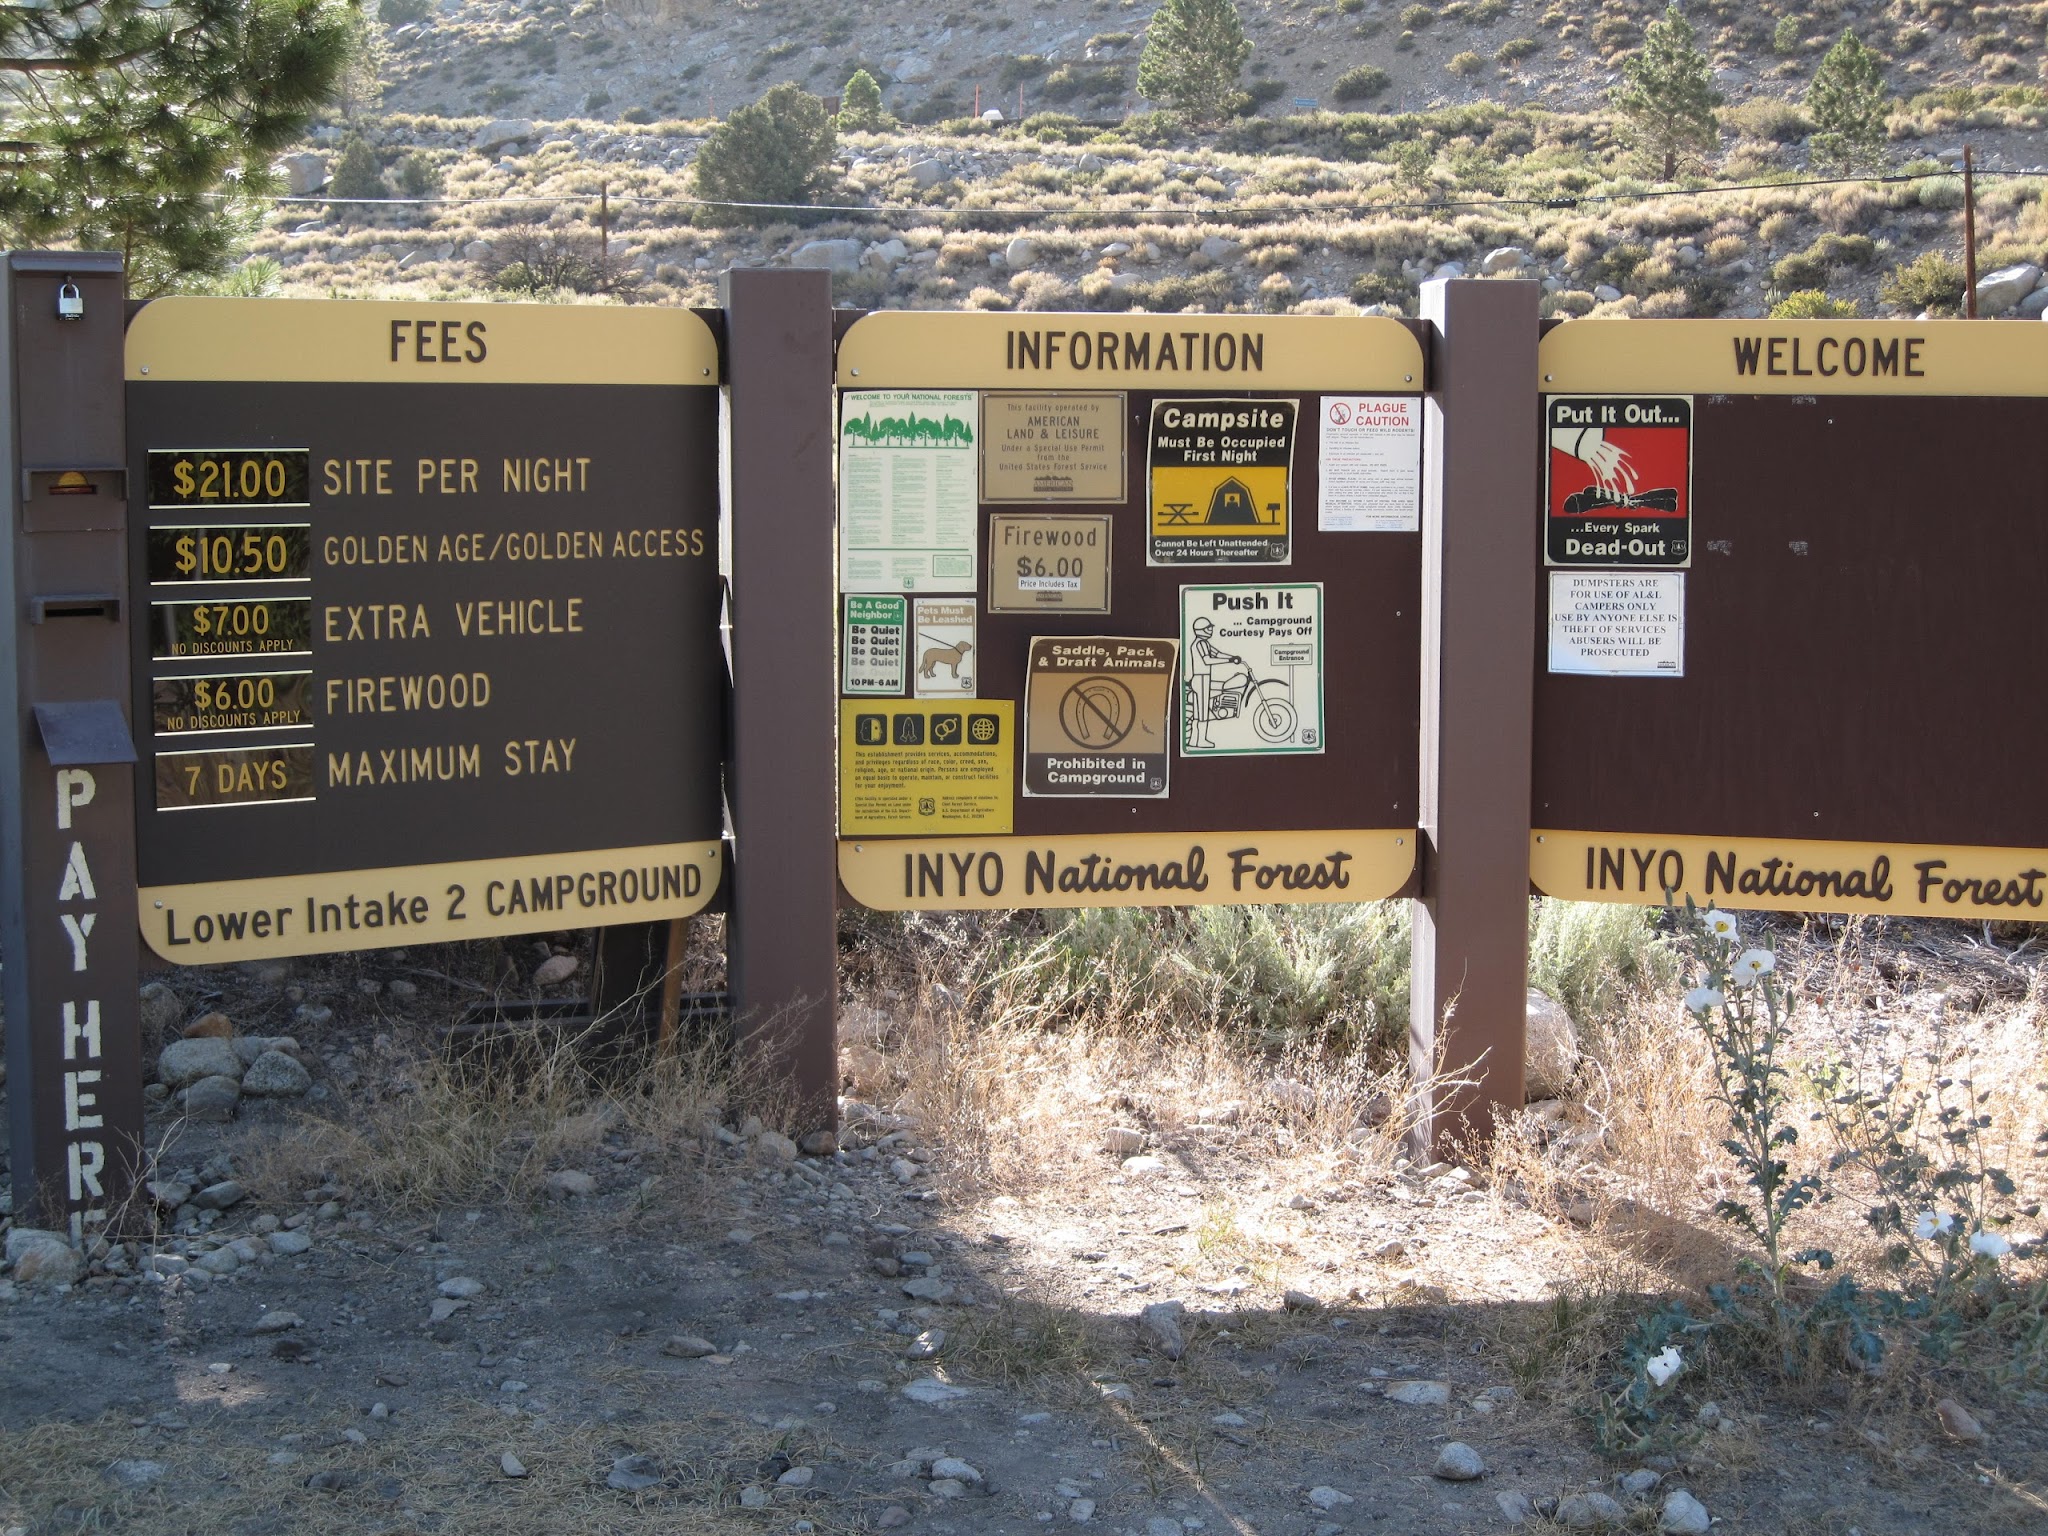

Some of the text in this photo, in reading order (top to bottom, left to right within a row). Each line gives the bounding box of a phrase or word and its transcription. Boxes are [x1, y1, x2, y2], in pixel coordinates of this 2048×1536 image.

[391, 320, 487, 363] FEES
[1006, 331, 1264, 372] INFORMATION
[1733, 338, 1925, 376] WELCOME
[1025, 404, 1051, 412] facility
[1055, 404, 1087, 412] operated
[1091, 404, 1099, 412] by
[1359, 403, 1407, 412] PLAGUE
[1557, 405, 1680, 423] Put It Out...
[1028, 416, 1080, 426] AMERICAN
[1164, 408, 1284, 431] Campsite
[1356, 416, 1409, 426] CAUTION
[1007, 429, 1099, 439] LAND & LEISURE
[1158, 436, 1285, 450] Must Be Occupied
[1184, 450, 1257, 463] First Night
[174, 459, 286, 498] $21.00
[323, 457, 590, 496] SITE PER NIGHT
[1571, 522, 1660, 535] ...Every Spark
[1005, 526, 1096, 546] Firewood
[324, 528, 703, 565] GOLDEN AGE/GOLDEN ACCESS
[1155, 540, 1185, 548] Cannot
[1565, 539, 1665, 556] Dead-Out
[175, 535, 287, 573] $10.50
[1017, 555, 1083, 577] $6.00
[1039, 580, 1064, 588] Includes
[1573, 579, 1659, 587] DUMPSTERS ARE
[851, 601, 863, 609] Be
[875, 601, 899, 609] Good
[1213, 592, 1293, 610] Push It
[1575, 602, 1656, 610] CAMPERS ONLY
[193, 605, 269, 637] $7.00
[325, 598, 583, 642] EXTRA VEHICLE
[851, 611, 892, 620] Neighbor
[1640, 614, 1665, 622] ELSE
[1247, 616, 1312, 630] Campground
[1562, 625, 1596, 633] THEFT
[852, 626, 899, 635] Be Quiet
[1220, 627, 1312, 637] Courtesy Pays Off
[172, 637, 294, 655] NO DISCOUNTS APPLY
[852, 636, 899, 645] Be Quiet
[852, 647, 899, 656] Be Quiet
[1052, 646, 1154, 657] Saddle, Pack
[1580, 648, 1649, 656] PROSECUTED
[871, 658, 899, 666] Quiet
[1038, 657, 1165, 668] & Draft Animals
[194, 678, 275, 711] $6.00
[328, 672, 491, 714] FIREWOOD
[168, 709, 301, 730] NO DISCOUNTS APPLY
[329, 738, 577, 787] MAXIMUM STAY
[1047, 758, 1145, 769] Prohibited in
[185, 760, 287, 796] 7 DAYS
[1047, 772, 1145, 785] Campground
[57, 769, 97, 972] PAY
[905, 846, 1352, 897] INYO National Forest
[1587, 847, 2046, 907] INYO National Forest
[166, 863, 700, 945] Lower Intake 2 CAMPGROUND
